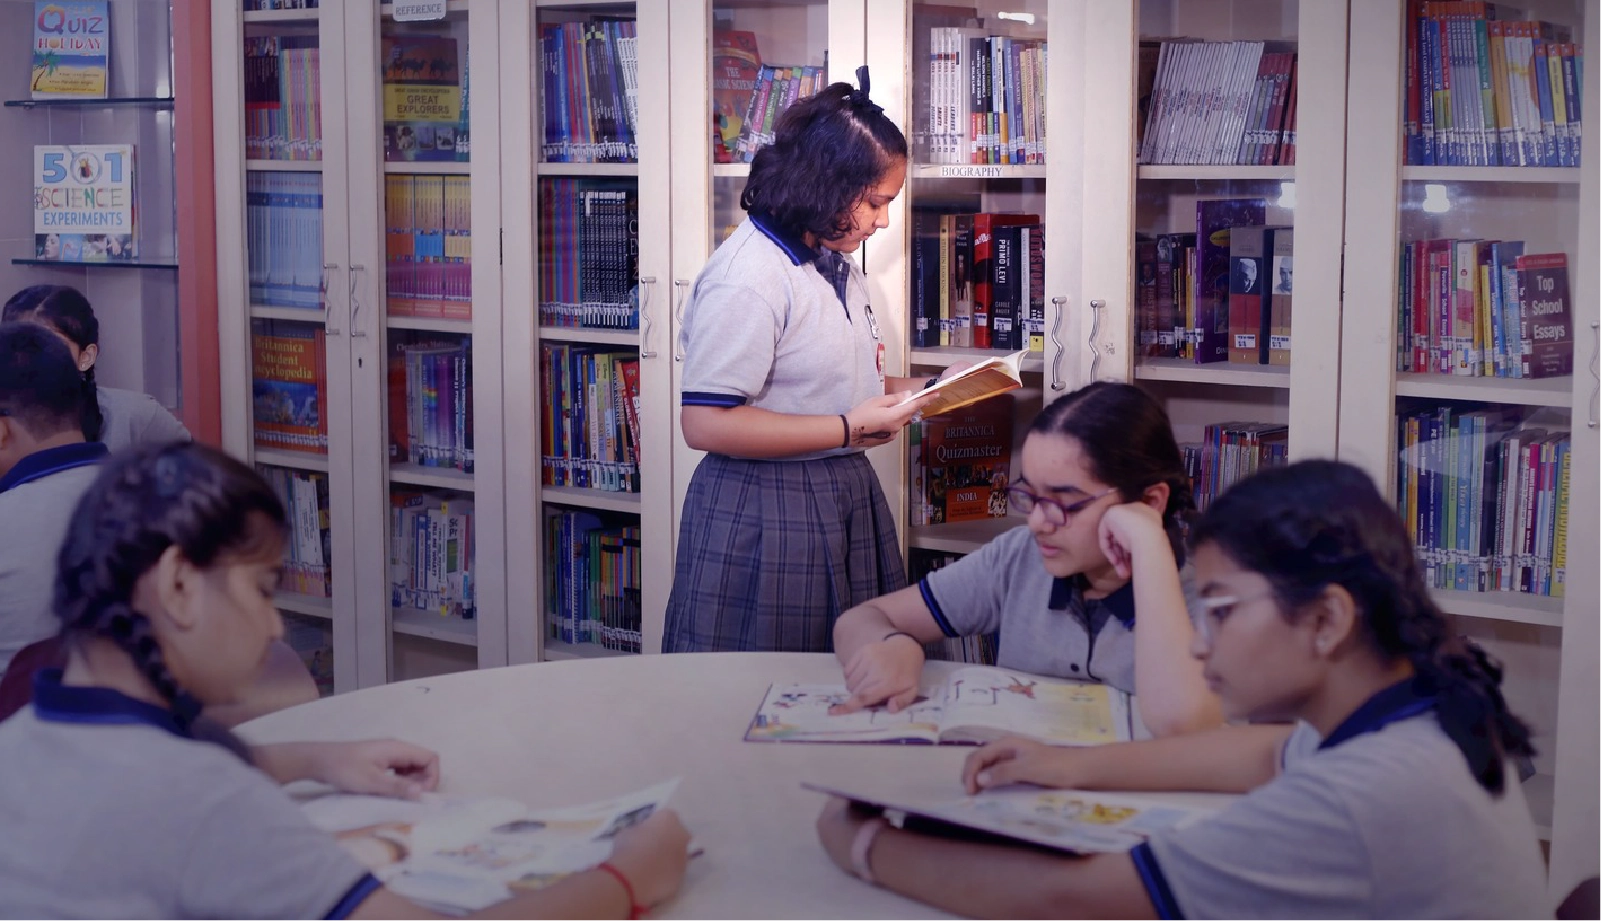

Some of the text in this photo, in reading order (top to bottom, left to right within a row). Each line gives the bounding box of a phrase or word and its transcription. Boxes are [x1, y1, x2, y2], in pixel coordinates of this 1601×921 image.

[396, 3, 441, 15] REFERENCE
[38, 4, 104, 34] QUIZ
[38, 38, 101, 49] HOLIDAY
[407, 95, 438, 104] GREAT
[397, 105, 449, 114] EXPLORERS
[942, 166, 1003, 177] BIOGRAPHY
[41, 187, 124, 208] SCIENCE
[43, 212, 123, 226] EXPERIMENTS
[1536, 275, 1554, 293] Top
[1533, 298, 1563, 316] School
[1534, 324, 1565, 341] Essays
[261, 353, 298, 365] Student
[255, 364, 313, 380] ncyclopedia
[945, 425, 995, 439] BRITANNICA
[936, 443, 1002, 463] Quizmaster
[956, 493, 977, 502] INDIA
